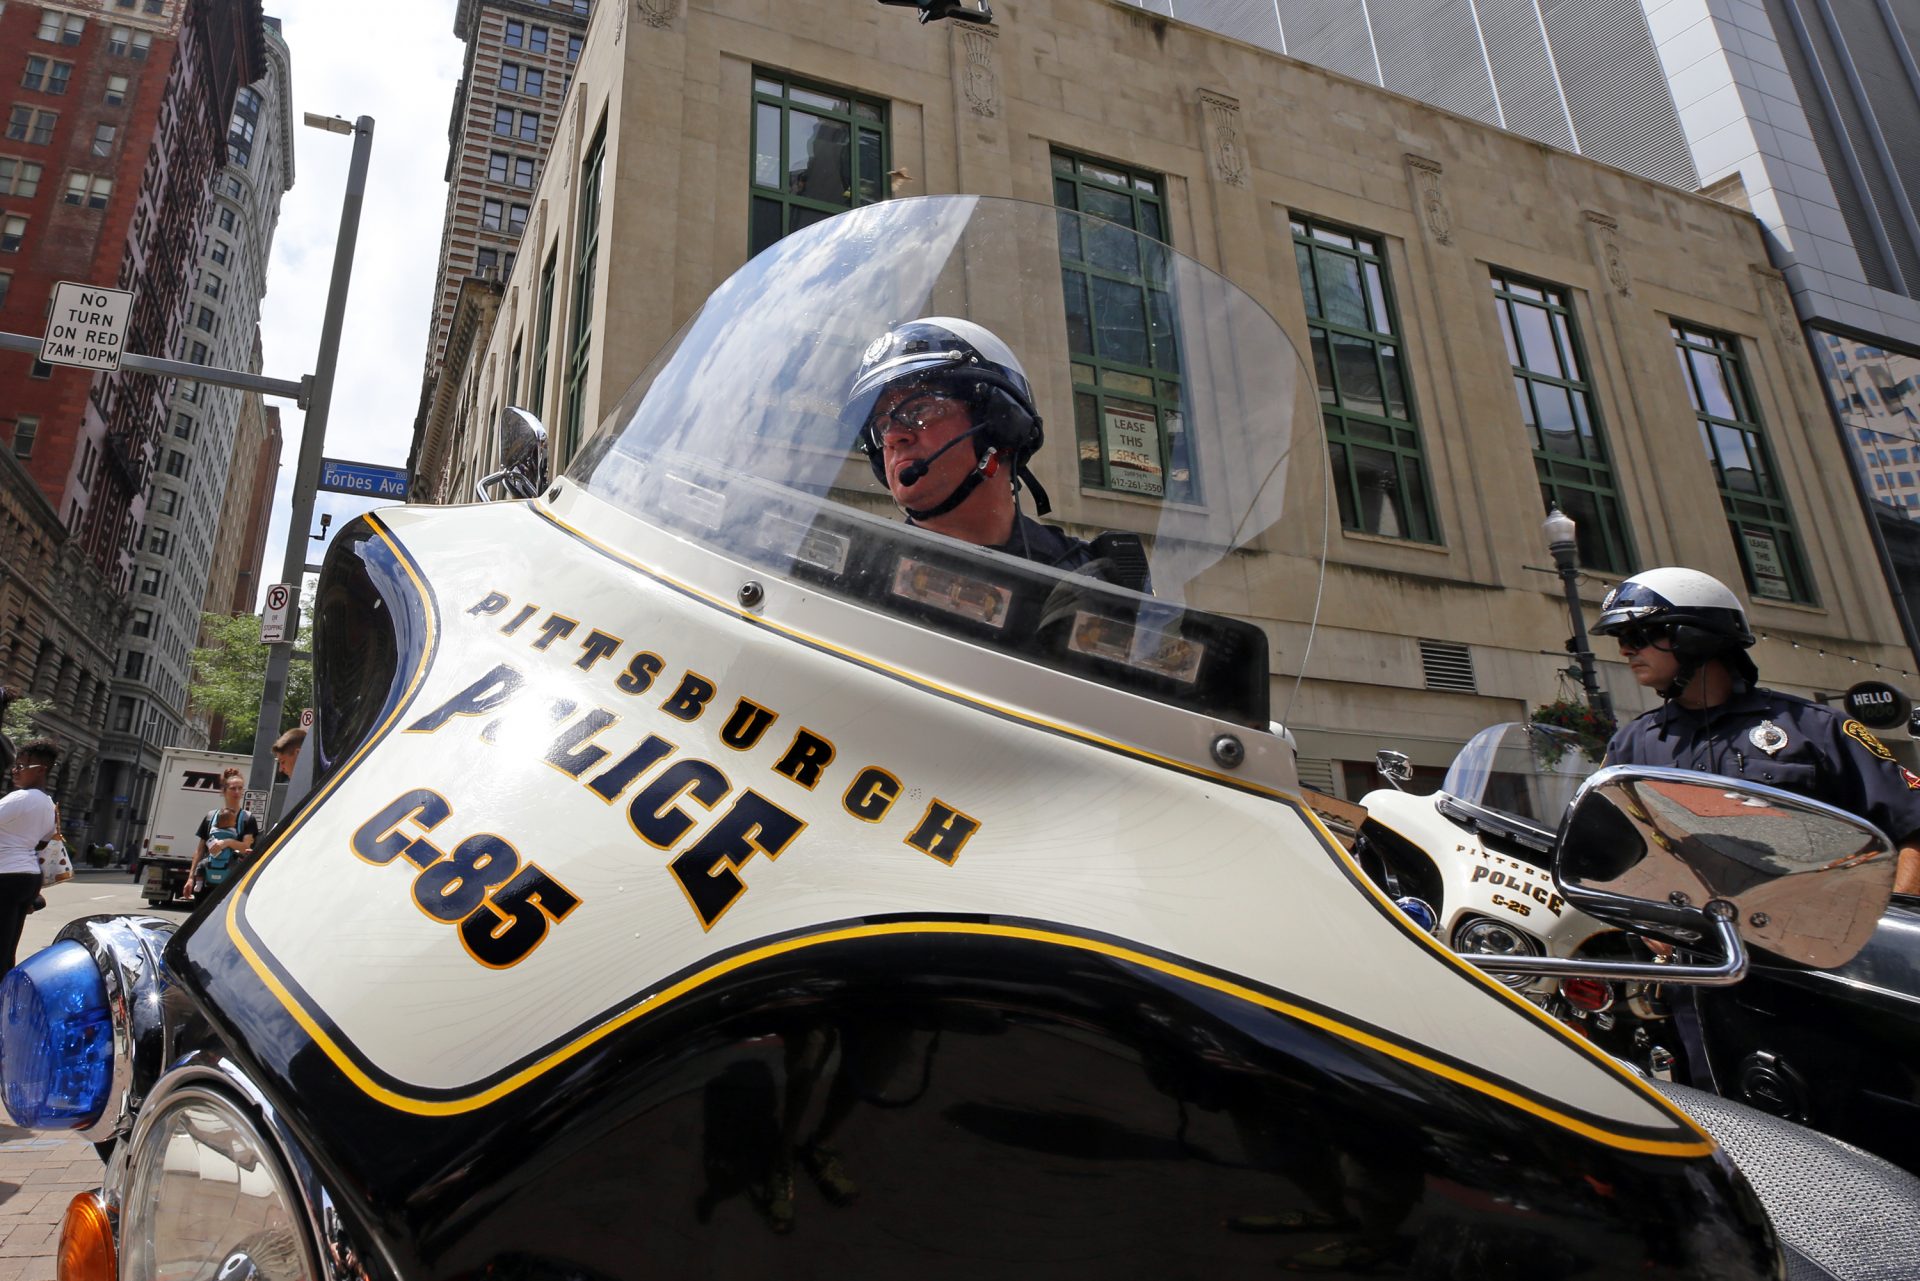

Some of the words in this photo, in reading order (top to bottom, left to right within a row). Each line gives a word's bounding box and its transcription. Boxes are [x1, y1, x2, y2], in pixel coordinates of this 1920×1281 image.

[80, 293, 107, 308] NO
[69, 309, 113, 327] TURN
[53, 325, 76, 340] ON
[86, 330, 119, 345] RED
[48, 342, 117, 364] 7AM-10PM
[1114, 418, 1147, 433] LEASE
[1120, 435, 1143, 448] THIS
[1116, 449, 1149, 464] SPACE
[324, 470, 372, 490] Forbes
[379, 478, 404, 495] Ave
[1111, 477, 1162, 493] 412-261-3550
[1853, 691, 1893, 705] HELLO
[465, 590, 983, 868] PITTSBURGH
[1456, 844, 1551, 882] PITTSBU
[349, 787, 584, 971] C-85
[1470, 865, 1566, 919] POLICE
[1491, 894, 1532, 917] C-25
